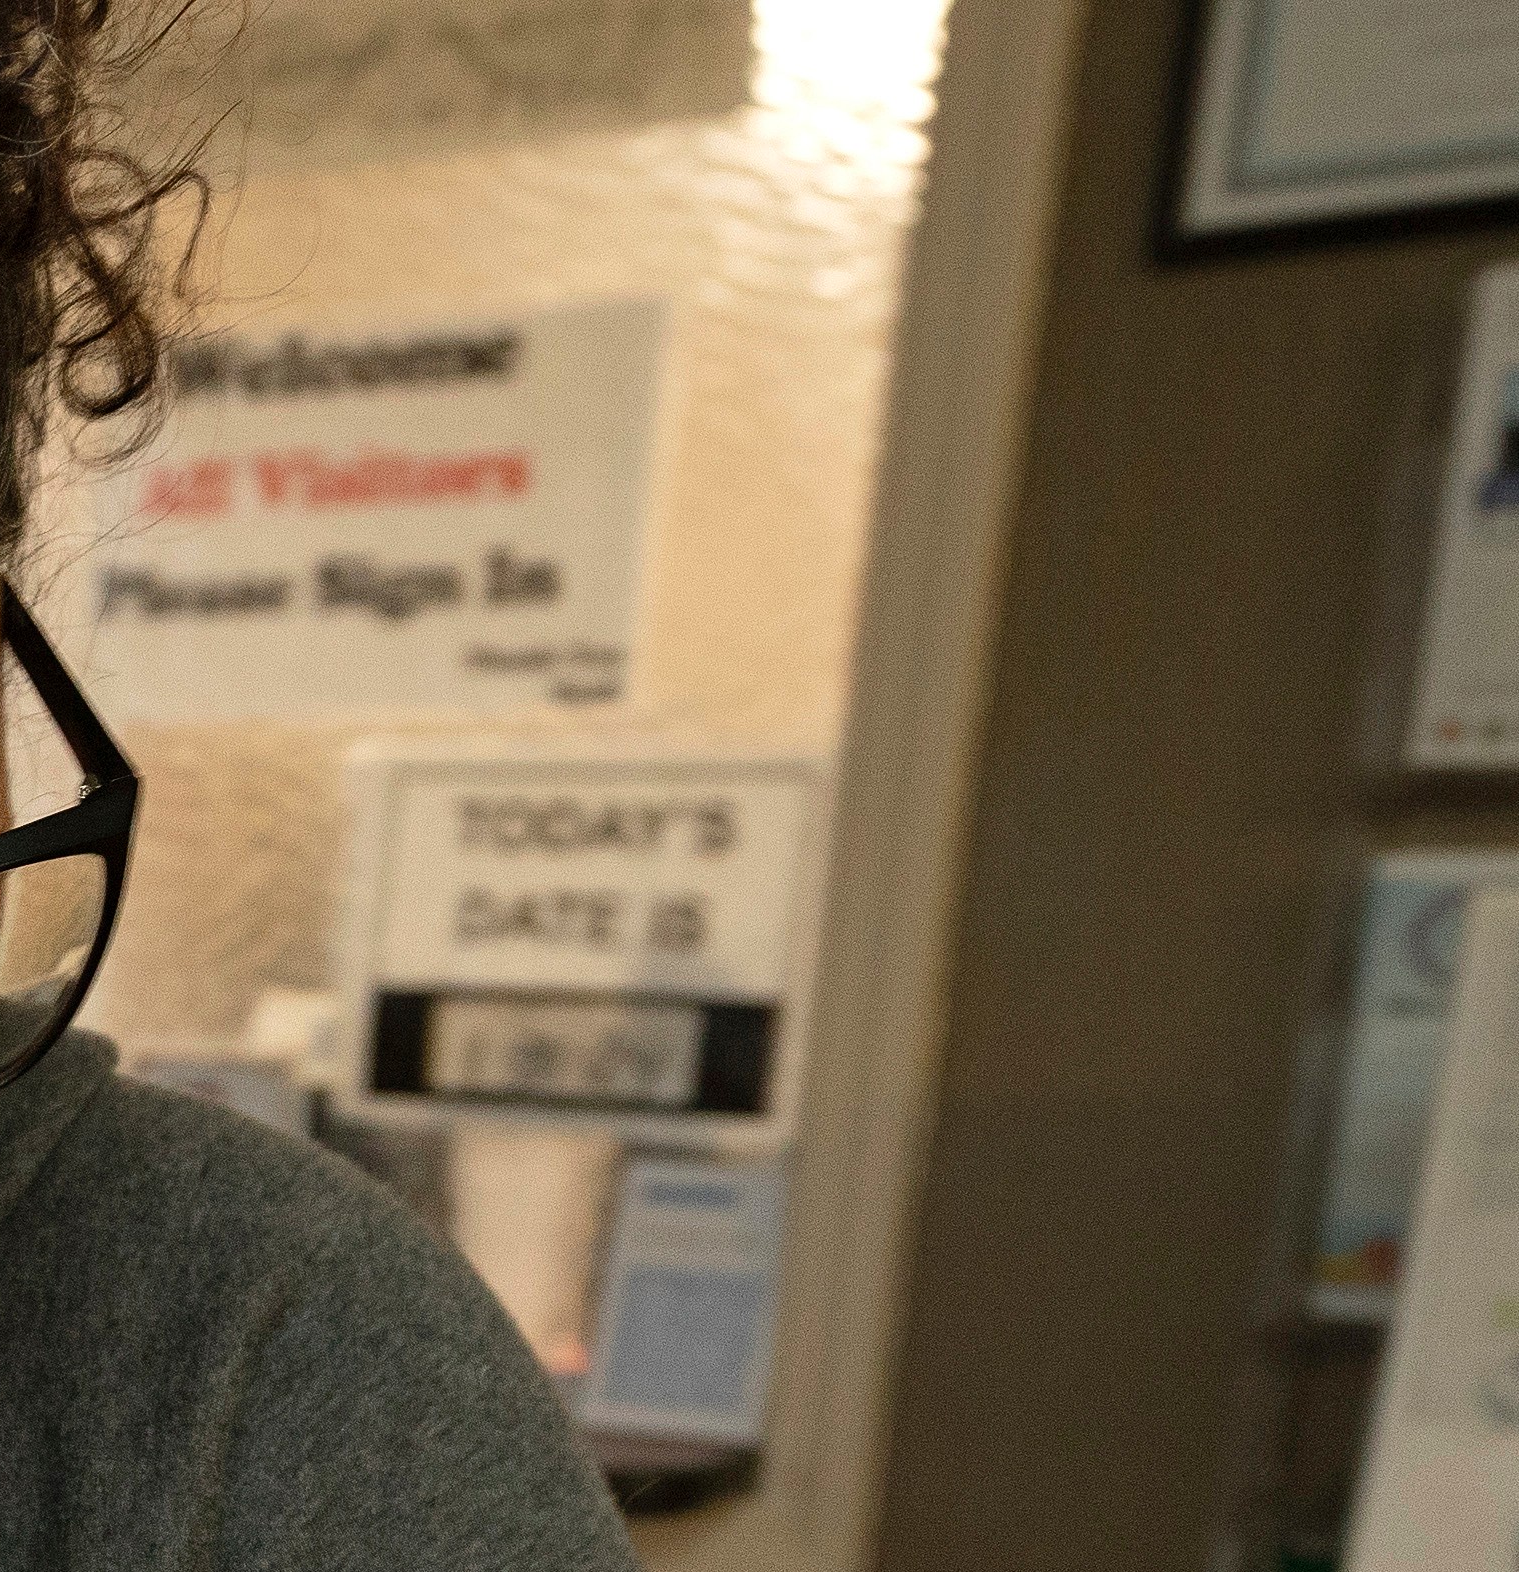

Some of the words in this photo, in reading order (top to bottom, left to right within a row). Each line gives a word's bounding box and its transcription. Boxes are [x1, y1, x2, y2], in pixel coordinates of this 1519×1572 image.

[149, 325, 523, 400] Welcome
[139, 456, 233, 520] All
[251, 446, 533, 512] Visitors
[95, 560, 293, 622] Please
[313, 550, 463, 622] Sign
[483, 542, 563, 608] In
[455, 794, 737, 854] TODAY'S
[455, 888, 623, 952] DATE
[649, 892, 709, 952] IS
